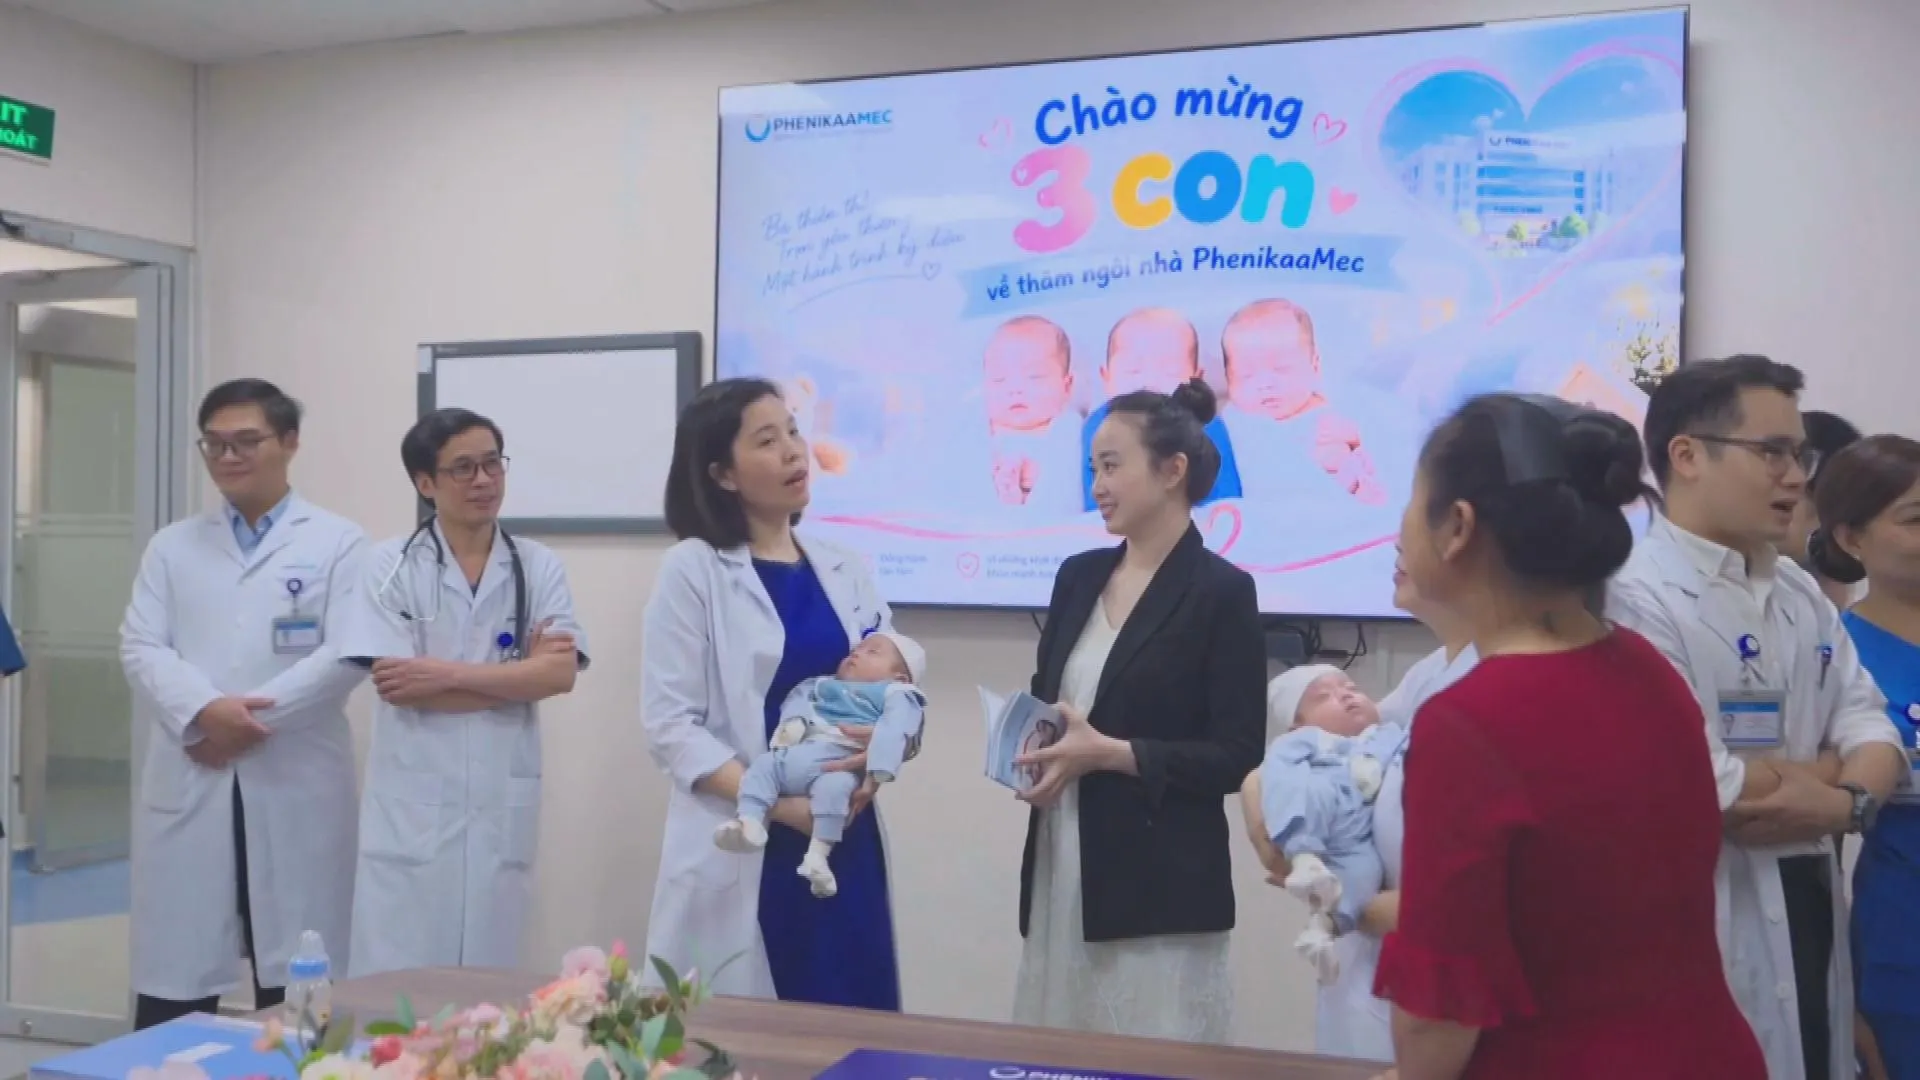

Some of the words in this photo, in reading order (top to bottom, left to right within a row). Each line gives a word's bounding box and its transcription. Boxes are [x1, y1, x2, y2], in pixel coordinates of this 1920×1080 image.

[0, 102, 27, 125] IT
[772, 109, 893, 132] PHENIKAAMEC
[1035, 86, 1158, 145] Chào
[1174, 74, 1304, 139] mừng
[1011, 144, 1095, 253] 3
[1112, 150, 1315, 229] con
[987, 272, 1011, 301] về
[1016, 270, 1074, 295] thăm
[1082, 254, 1131, 290] ngôi
[1140, 249, 1183, 275] nhà
[1193, 246, 1365, 273] PhenikaaMec
